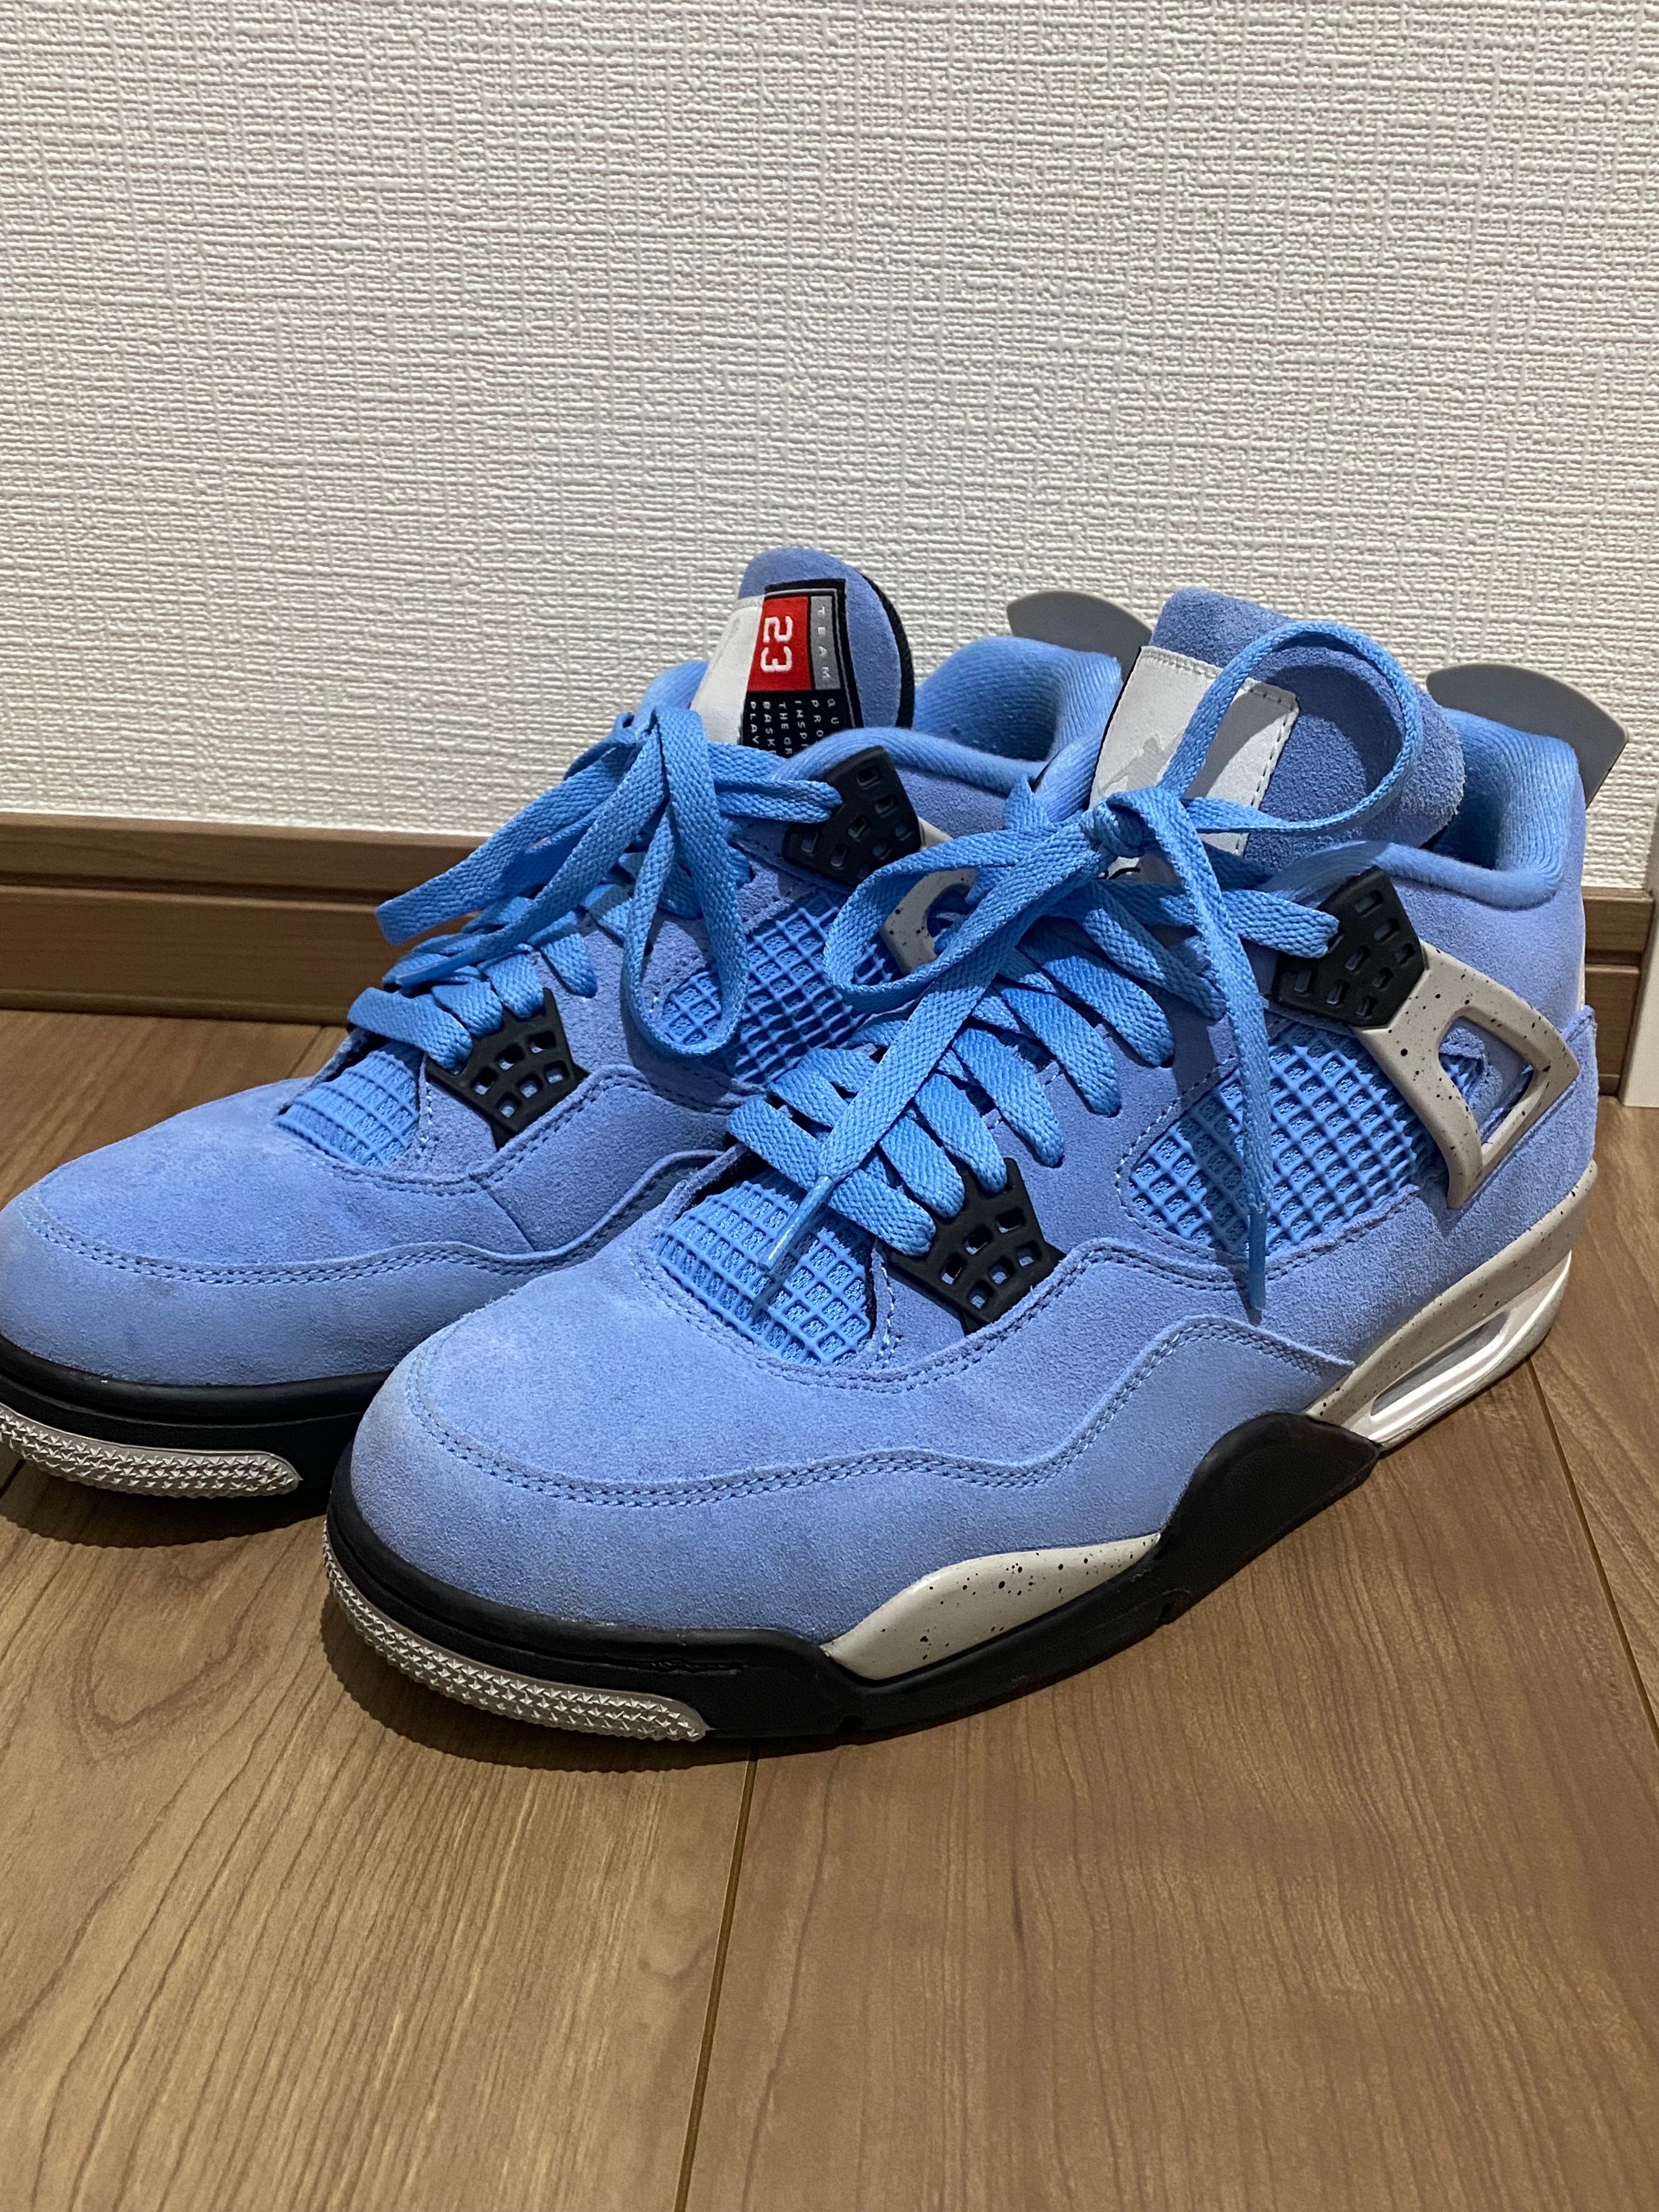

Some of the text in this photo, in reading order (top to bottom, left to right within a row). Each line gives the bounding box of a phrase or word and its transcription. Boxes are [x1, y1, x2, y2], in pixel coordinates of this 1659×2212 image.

[760, 616, 793, 672] 23
[817, 606, 831, 678] TEAM
[778, 702, 789, 730] THE
